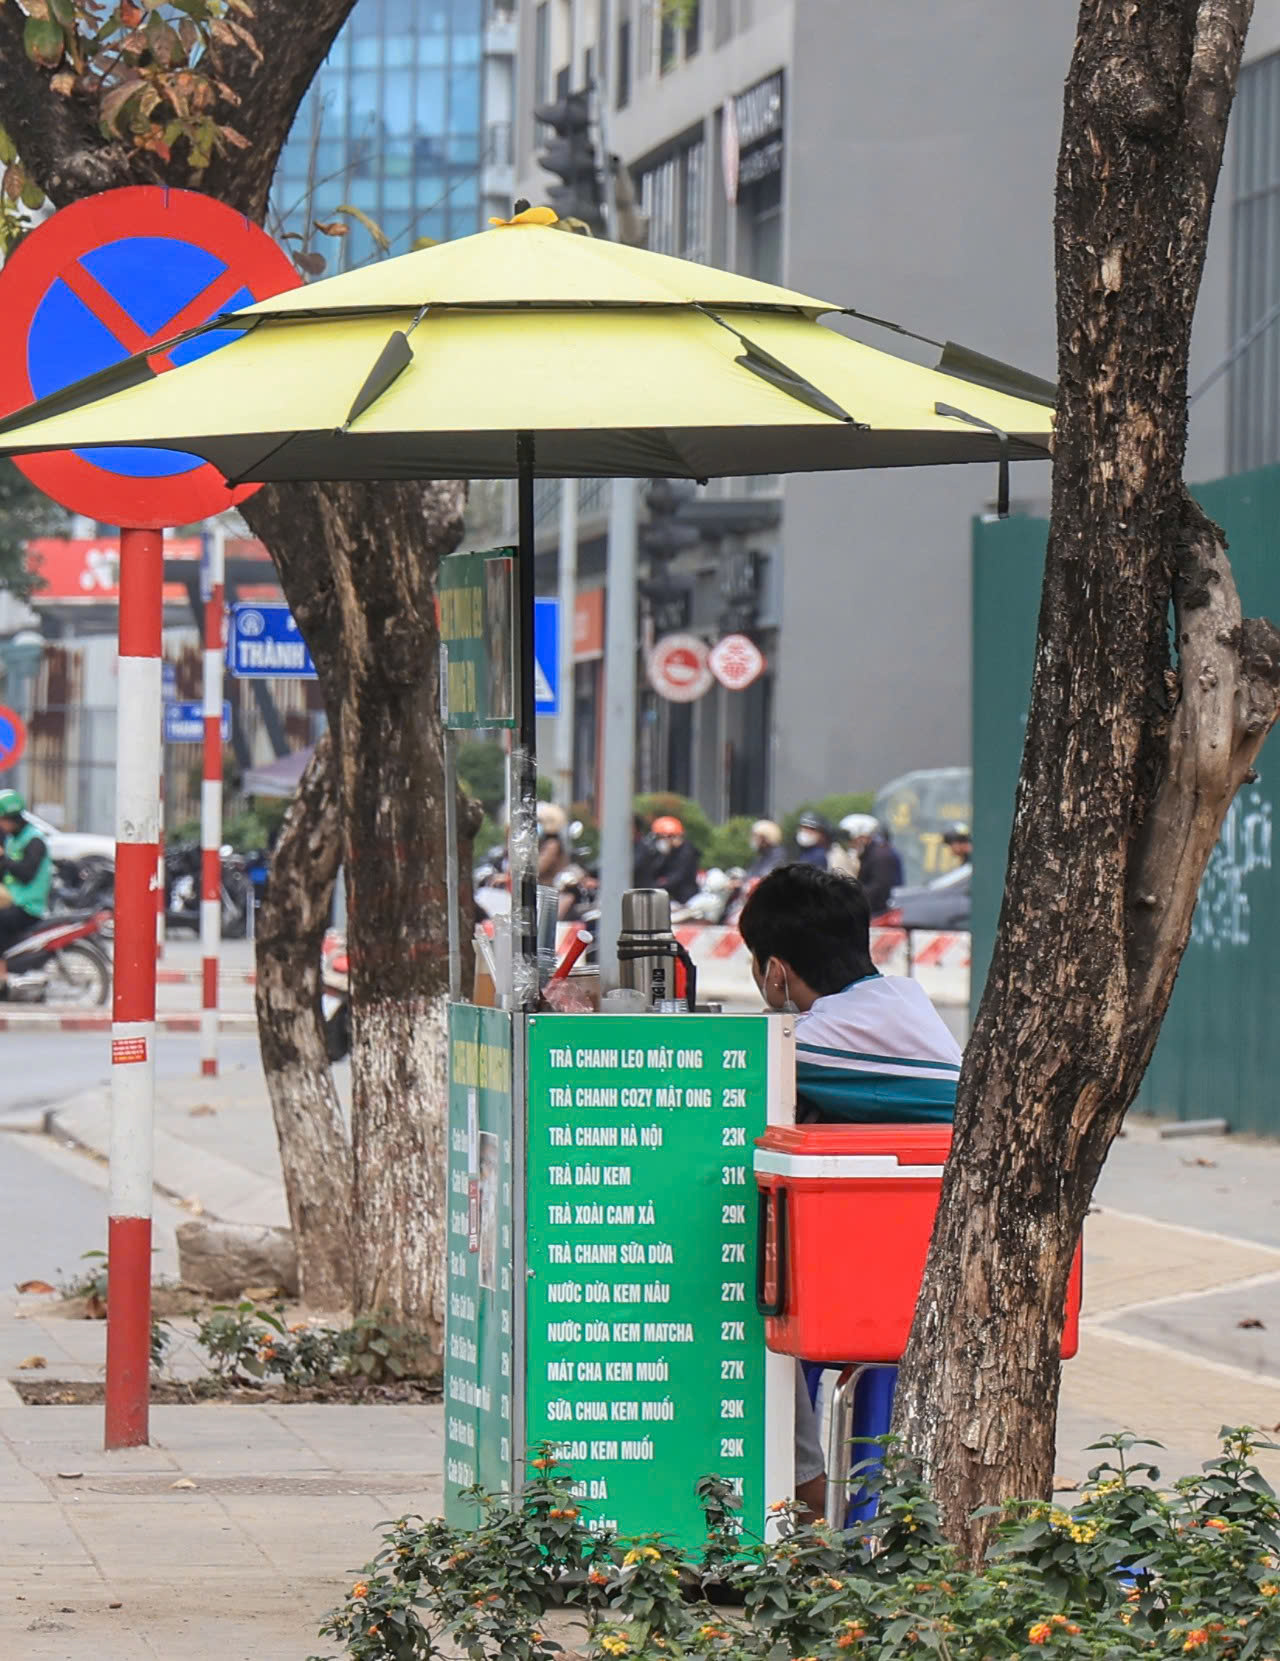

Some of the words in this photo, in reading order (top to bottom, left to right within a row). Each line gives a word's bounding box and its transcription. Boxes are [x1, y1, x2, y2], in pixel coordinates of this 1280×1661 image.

[550, 1046, 573, 1067] TRÀ
[576, 1049, 618, 1068] CHANH
[622, 1050, 644, 1068] LEO
[648, 1046, 674, 1072] MẬT
[677, 1050, 703, 1068] ONG
[723, 1050, 746, 1068] 27K
[549, 1085, 572, 1106] TRÀ
[576, 1088, 618, 1107] CHANH
[621, 1088, 652, 1107] COZY
[656, 1085, 683, 1111] MẬT
[686, 1089, 711, 1107] ONG
[723, 1089, 746, 1107] 25K
[549, 1124, 572, 1146] TRÀ
[576, 1128, 617, 1146] CHANH
[621, 1124, 637, 1146] HÀ
[641, 1124, 662, 1150] NỘI
[723, 1128, 745, 1146] 23K
[549, 1163, 572, 1185] TRÀ
[575, 1163, 600, 1185] DÂU
[604, 1167, 630, 1185] KEM
[722, 1167, 745, 1185] 31K
[549, 1202, 571, 1224] TRÀ
[575, 1202, 603, 1224] XOÀI
[607, 1206, 634, 1224] CAM
[639, 1200, 654, 1224] XẢ
[722, 1205, 745, 1223] 29K
[548, 1242, 572, 1263] TRÀ
[575, 1245, 617, 1263] CHANH
[621, 1242, 645, 1263] SỮA
[649, 1242, 673, 1263] DỪA
[722, 1244, 744, 1262] 27K
[548, 1281, 582, 1302] NƯỚC
[585, 1281, 610, 1302] DỪA
[614, 1284, 640, 1302] KEM
[644, 1280, 670, 1302] NÂU
[722, 1283, 744, 1301] 27K
[548, 1320, 581, 1342] NƯỚC
[585, 1320, 610, 1342] DỪA
[613, 1323, 640, 1342] KEM
[644, 1323, 693, 1342] MATCHA
[722, 1322, 744, 1340] 27K
[548, 1359, 574, 1381] MÁT
[578, 1362, 602, 1381] CHA
[606, 1362, 633, 1381] KEM
[637, 1356, 668, 1381] MUỐI
[721, 1361, 744, 1379] 27K
[548, 1399, 572, 1420] SỮA
[576, 1402, 608, 1420] CHUA
[611, 1402, 638, 1420] KEM
[642, 1396, 673, 1420] MUỐI
[721, 1400, 744, 1418] 29K
[591, 1441, 618, 1460] KEM
[622, 1435, 653, 1460] MUỐI
[721, 1439, 743, 1457] 29K
[590, 1477, 607, 1499] ĐÁ
